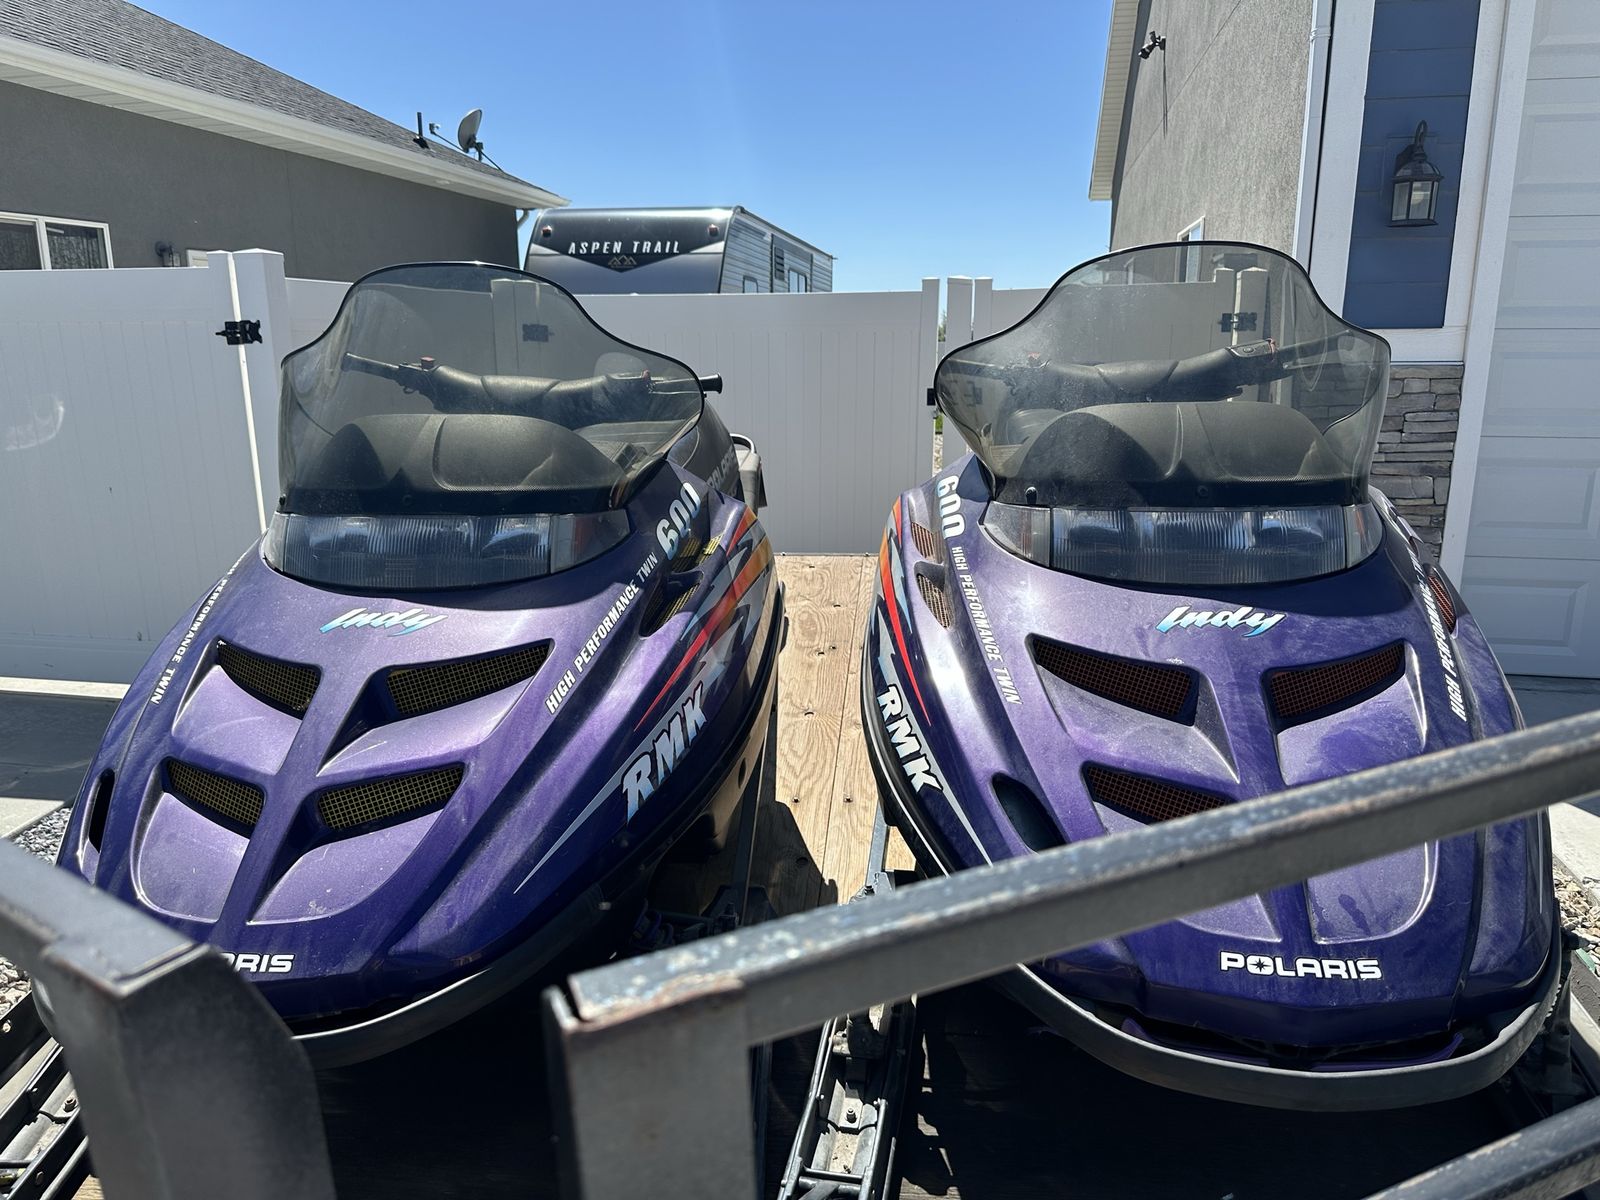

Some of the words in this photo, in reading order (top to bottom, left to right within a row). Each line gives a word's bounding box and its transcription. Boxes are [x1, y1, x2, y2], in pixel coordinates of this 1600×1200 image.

[568, 241, 623, 255] ASPEN
[632, 240, 681, 254] TRAIL
[936, 475, 967, 540] 600
[951, 546, 968, 571] HIGH
[545, 669, 576, 715] HIGH
[573, 579, 640, 673] PERFORMANCE
[636, 551, 659, 583] TWIN
[656, 482, 701, 561] 600
[959, 574, 1003, 661] PERFORMANCE
[171, 579, 228, 664] PERFORMANCE
[319, 607, 449, 637] Indy
[1155, 606, 1287, 638] Indy
[150, 667, 177, 705] TWIN
[993, 666, 1023, 705] TWIN
[1442, 676, 1467, 722] HIGH
[622, 681, 708, 824] RMK
[877, 684, 943, 793] RMK
[1220, 951, 1382, 980] POLARIS
